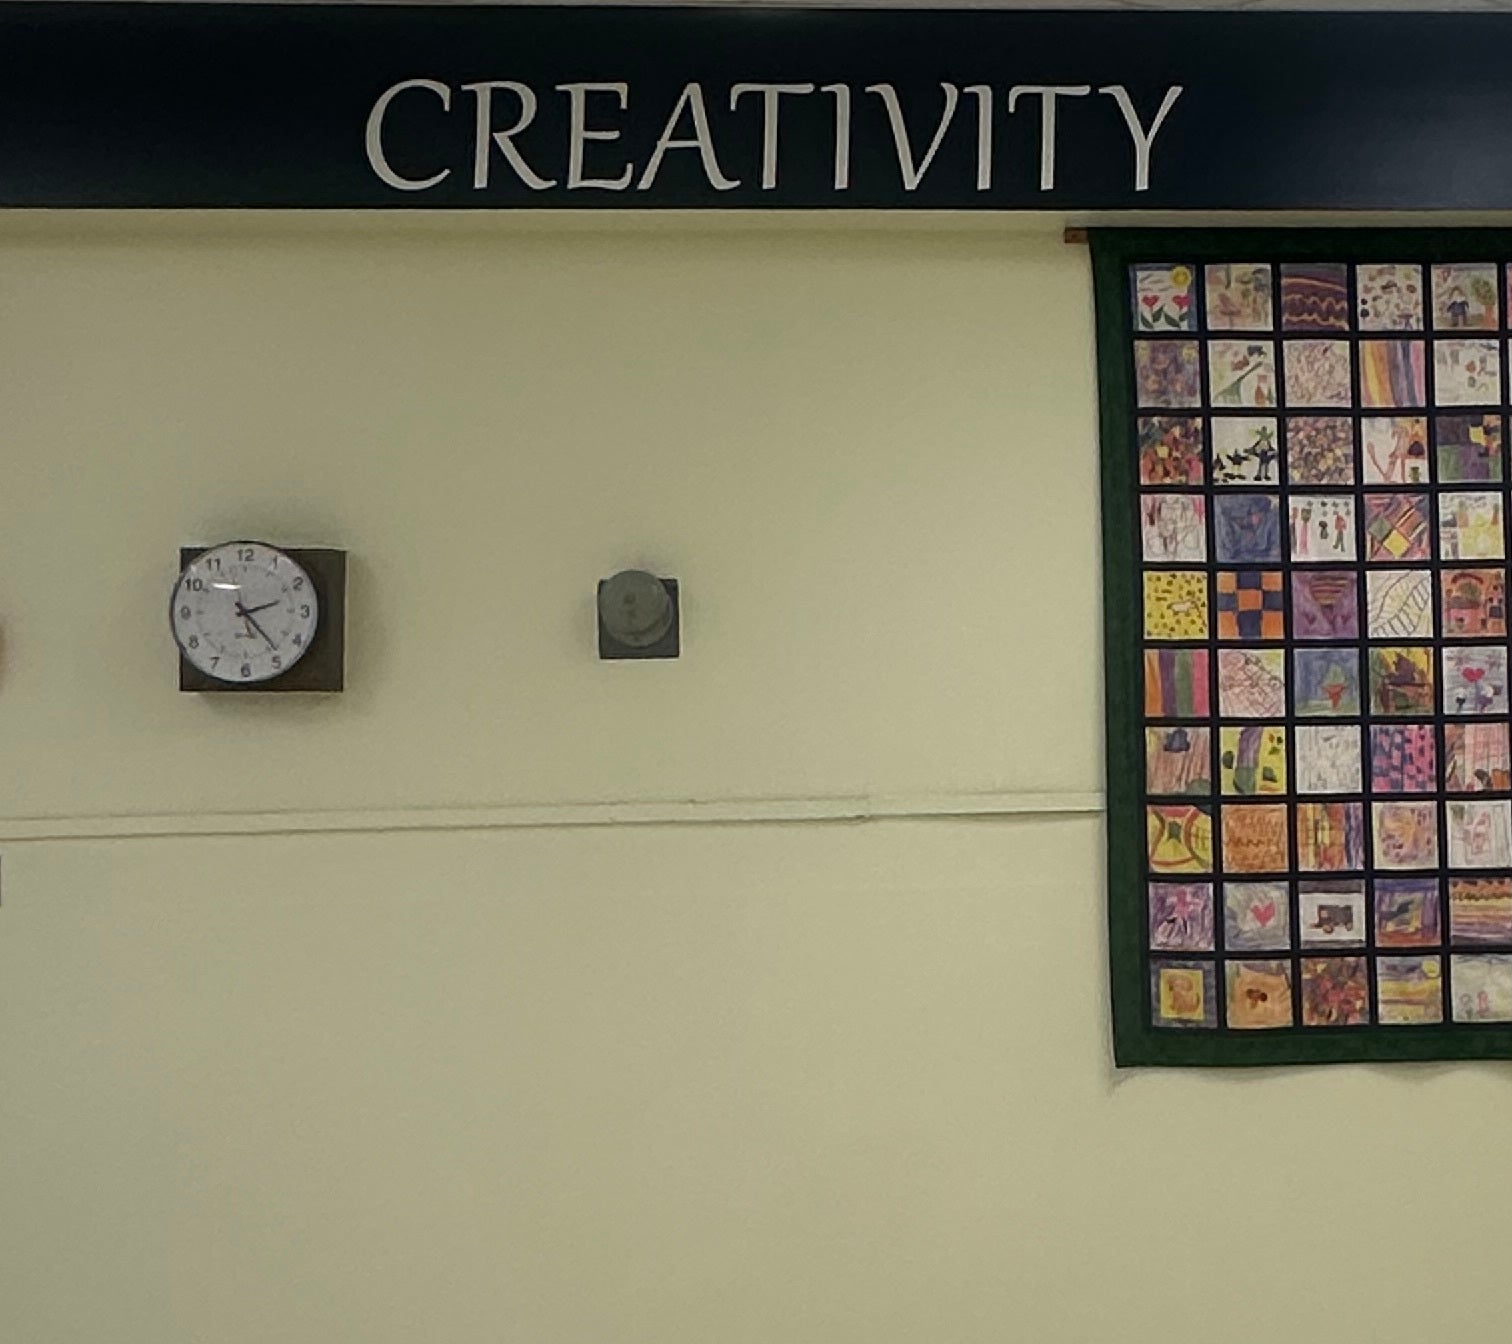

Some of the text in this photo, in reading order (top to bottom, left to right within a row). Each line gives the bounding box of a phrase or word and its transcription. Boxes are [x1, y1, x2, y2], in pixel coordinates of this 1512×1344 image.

[363, 78, 1185, 192] CREATIVITY
[237, 548, 254, 562] 12
[271, 555, 279, 569] 1
[206, 558, 221, 571] 11
[184, 578, 203, 592] 10
[292, 576, 304, 591] 2
[180, 605, 192, 620] 9
[299, 604, 310, 619] 3
[188, 634, 200, 649] 8
[291, 633, 302, 647] 4
[209, 656, 220, 670] 7
[240, 663, 252, 677] 6
[271, 656, 282, 670] 5
